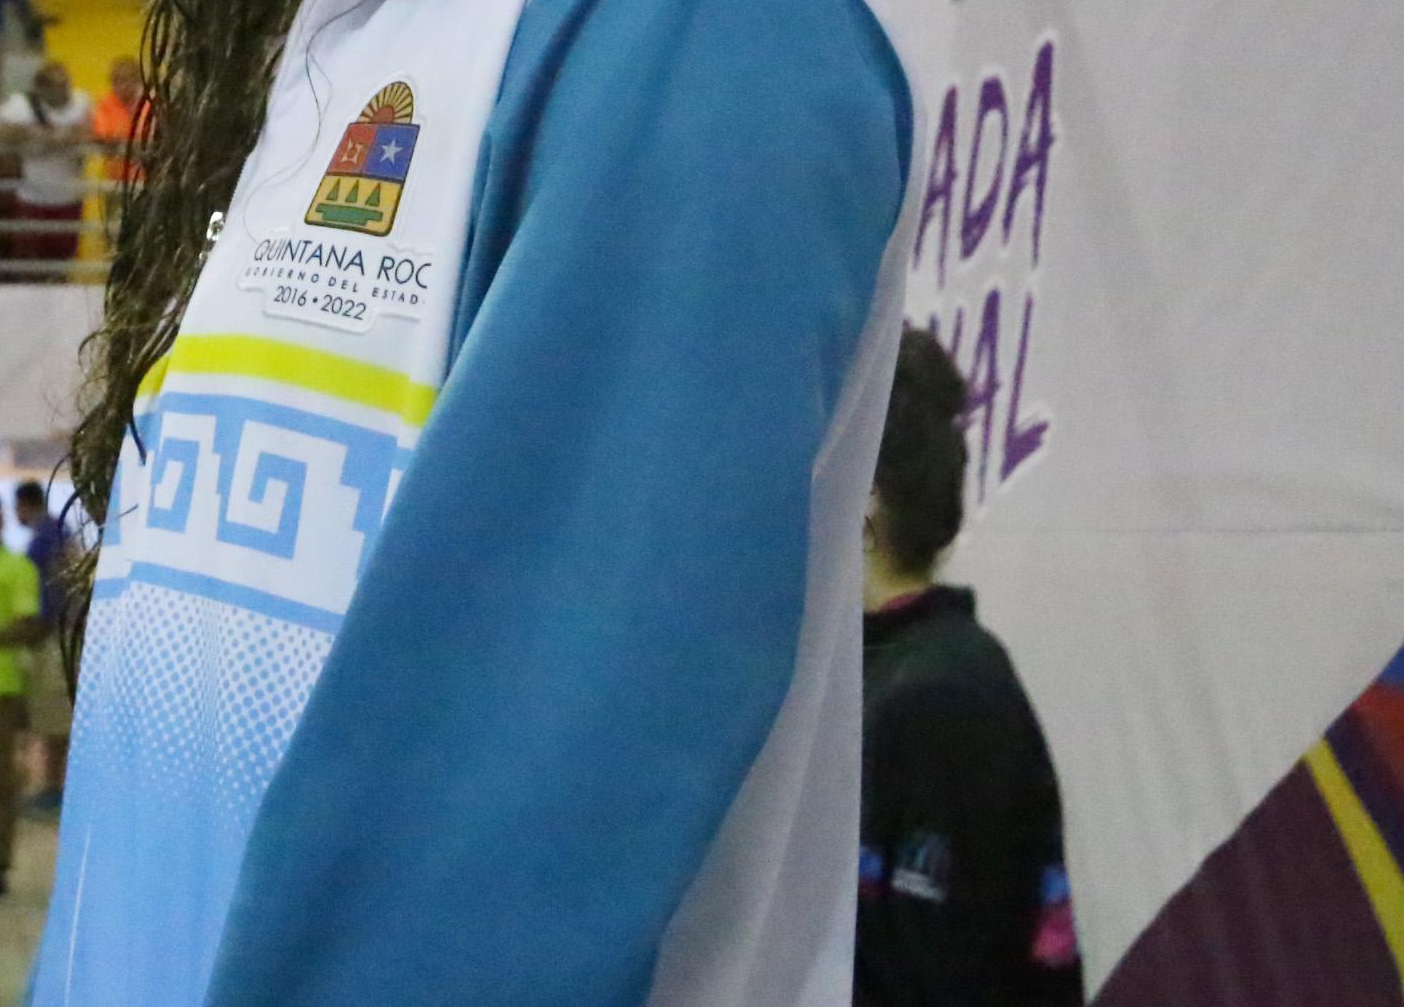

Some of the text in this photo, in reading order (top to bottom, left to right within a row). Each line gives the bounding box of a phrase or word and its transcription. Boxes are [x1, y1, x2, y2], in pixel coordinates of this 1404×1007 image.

[253, 238, 365, 277] QUINTANA
[327, 275, 359, 294] DEL
[371, 286, 426, 306] ESTAD
